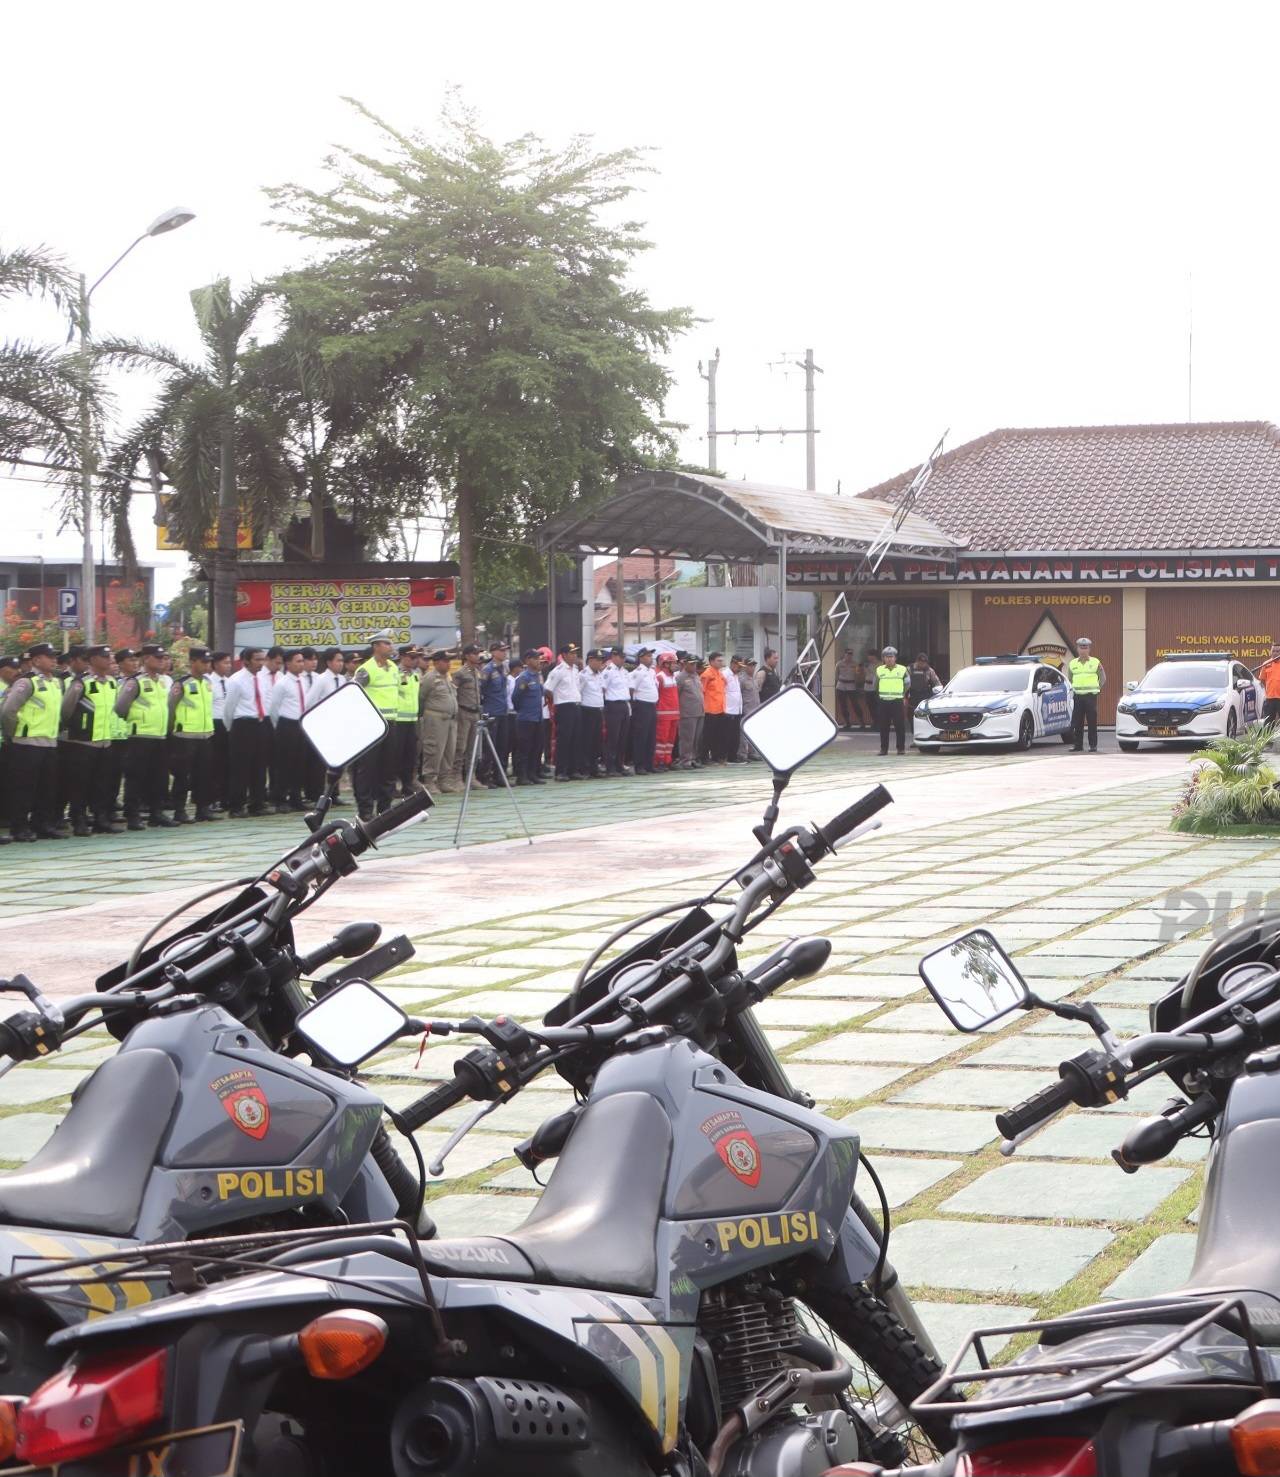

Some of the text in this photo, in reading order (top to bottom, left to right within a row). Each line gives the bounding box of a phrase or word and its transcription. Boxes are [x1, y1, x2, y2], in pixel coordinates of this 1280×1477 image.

[786, 560, 897, 582] SENTRA
[904, 559, 1073, 581] PELAYANAN
[1080, 558, 1257, 580] KEPOLISIAN
[272, 583, 411, 598] KERJA KERAS
[61, 593, 76, 613] P
[272, 600, 411, 614] KERJA CERDAS
[984, 595, 1112, 605] POLRES PURWOREJO
[272, 616, 411, 630] KERJA TUNTAS
[273, 633, 338, 646] KERJA
[1213, 635, 1239, 644] YANG
[217, 1168, 324, 1201] POLISI
[716, 1211, 819, 1252] POLISI
[428, 1246, 511, 1265] SUZUKI
